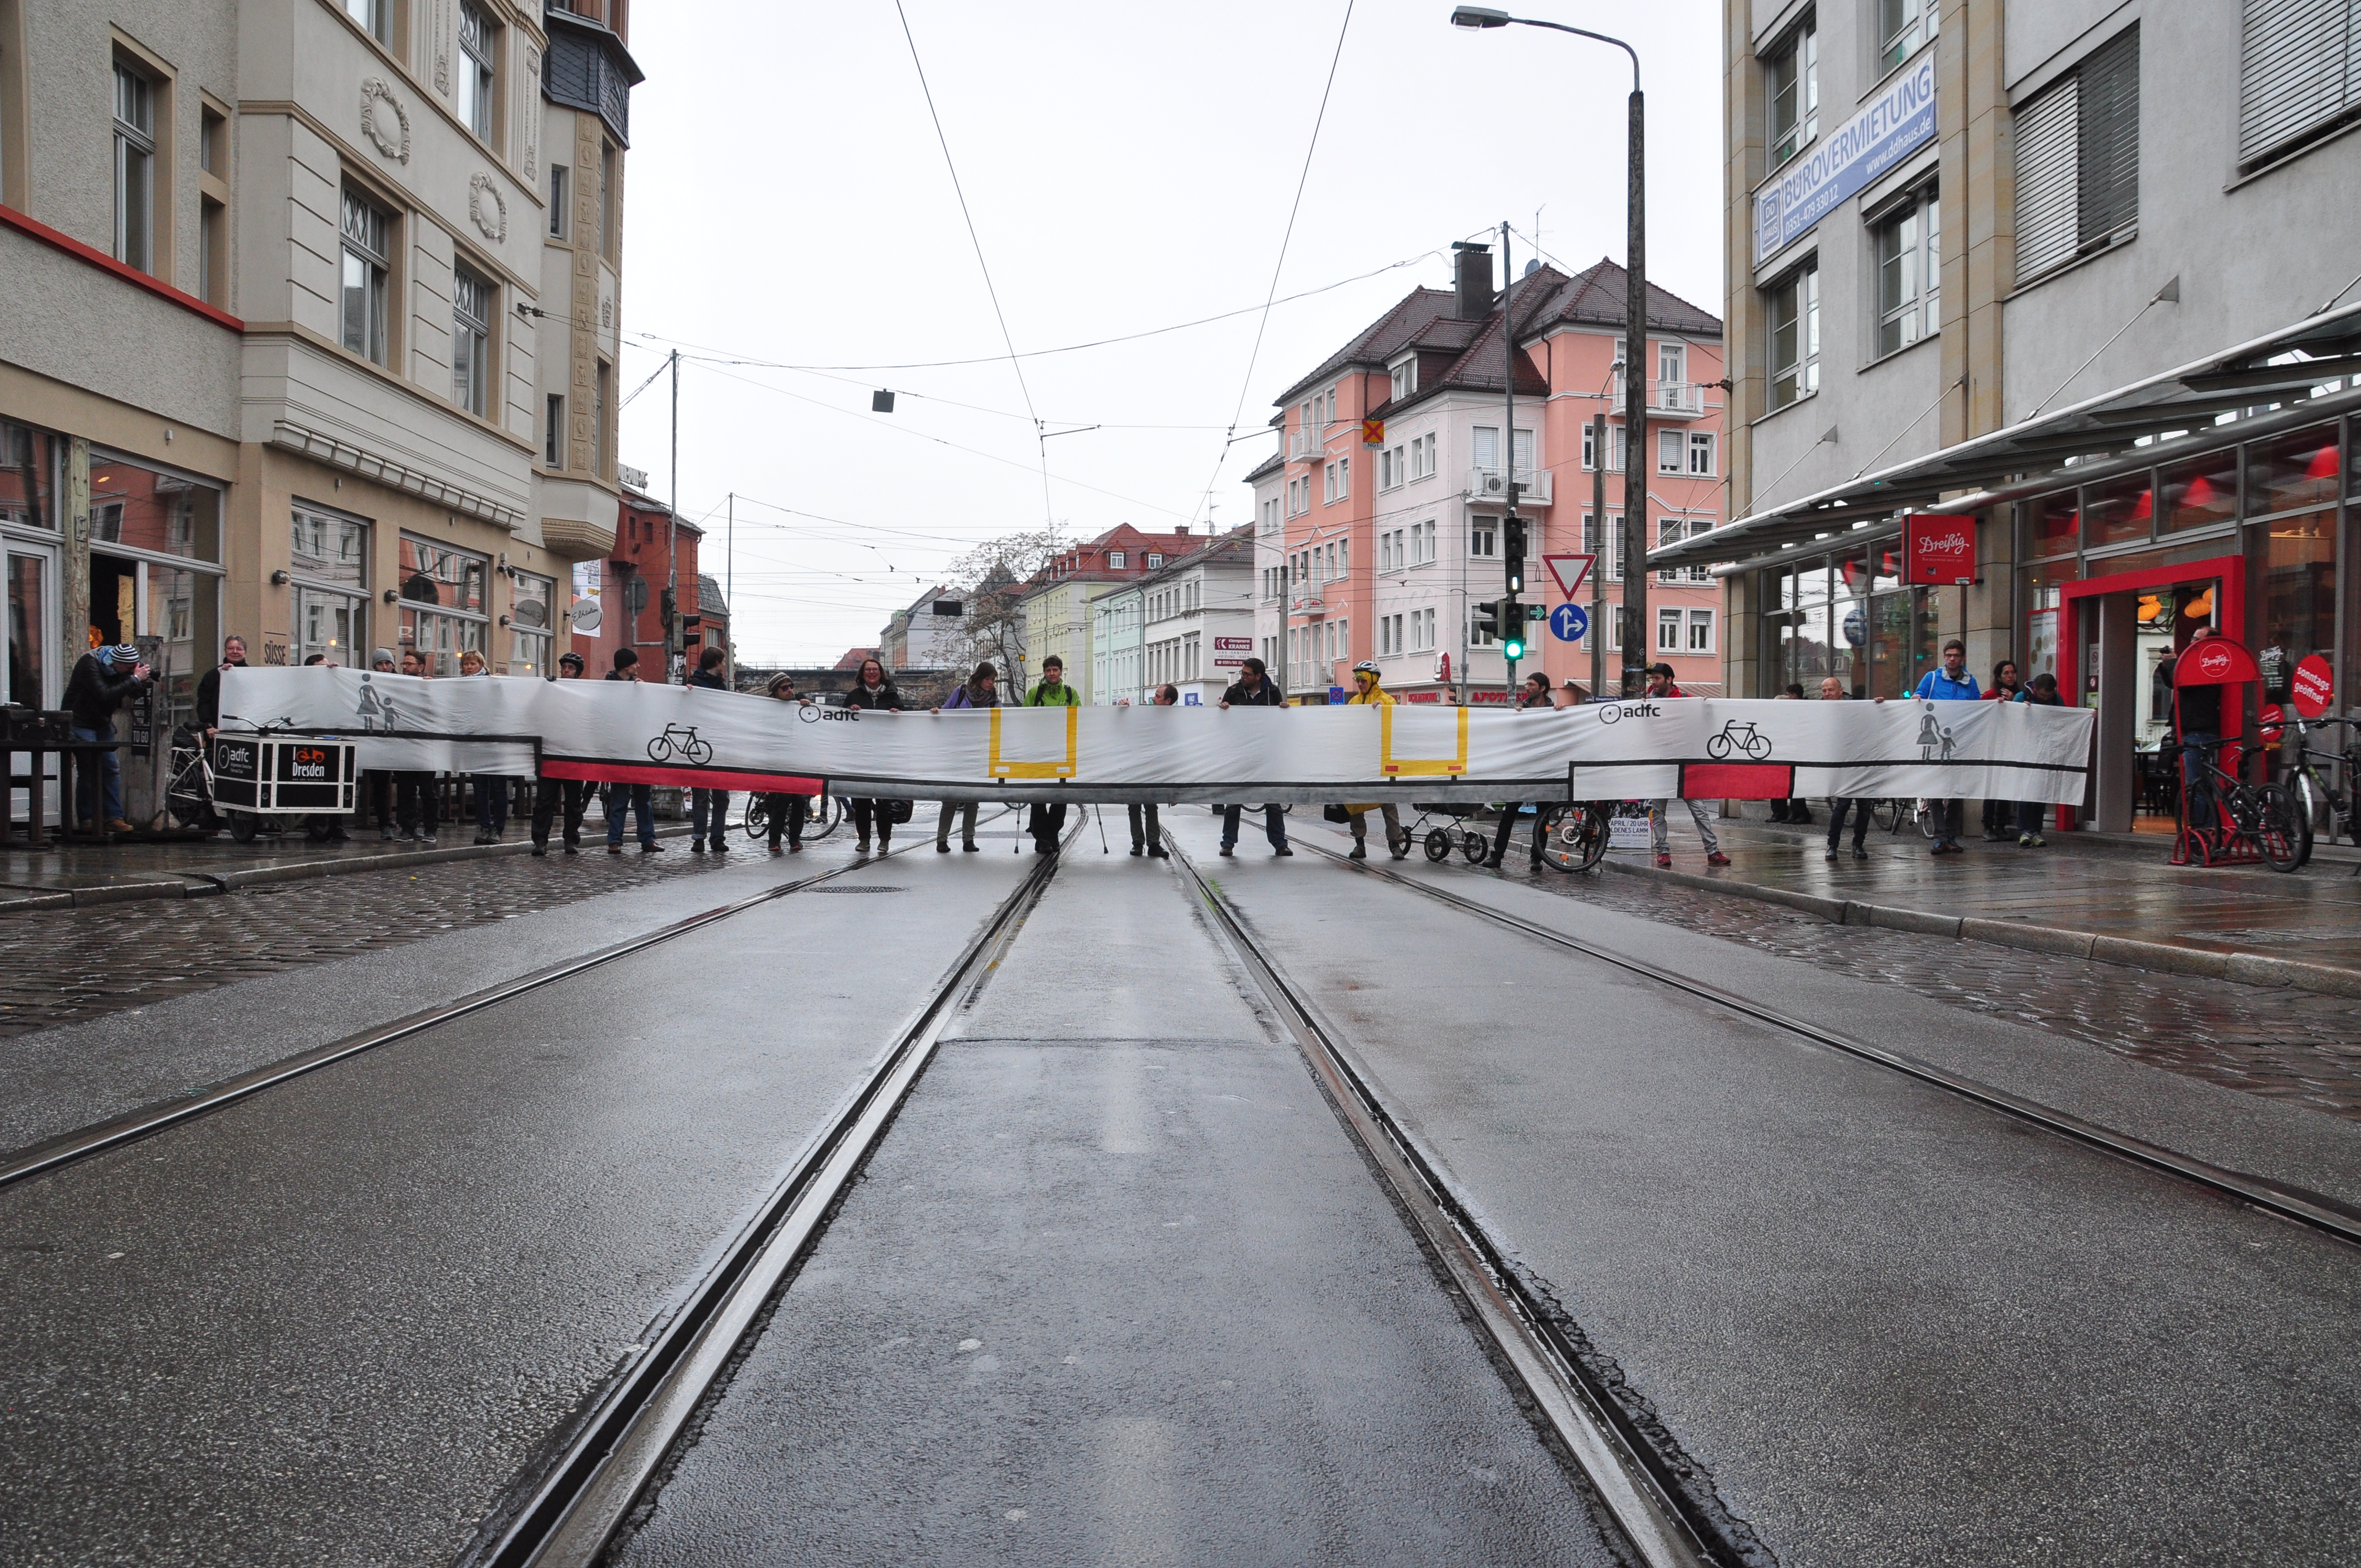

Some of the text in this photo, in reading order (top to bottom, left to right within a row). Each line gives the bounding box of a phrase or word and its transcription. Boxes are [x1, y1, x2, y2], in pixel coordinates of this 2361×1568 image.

[1785, 64, 1930, 210] BÜROVERMIETUNG
[1866, 115, 1931, 175] www.ddhaus.de
[1765, 202, 1775, 219] DD
[1764, 222, 1777, 241] HAUS
[1918, 532, 1970, 555] Dreißig
[264, 640, 286, 666] SÜSSE
[2297, 667, 2330, 691] sonntags
[2294, 682, 2324, 705] geöffnet
[823, 710, 859, 721] adfc
[1623, 704, 1661, 718] adfc
[133, 731, 149, 743] TO GO
[230, 748, 249, 763] adfc
[292, 762, 325, 777] Dresden
